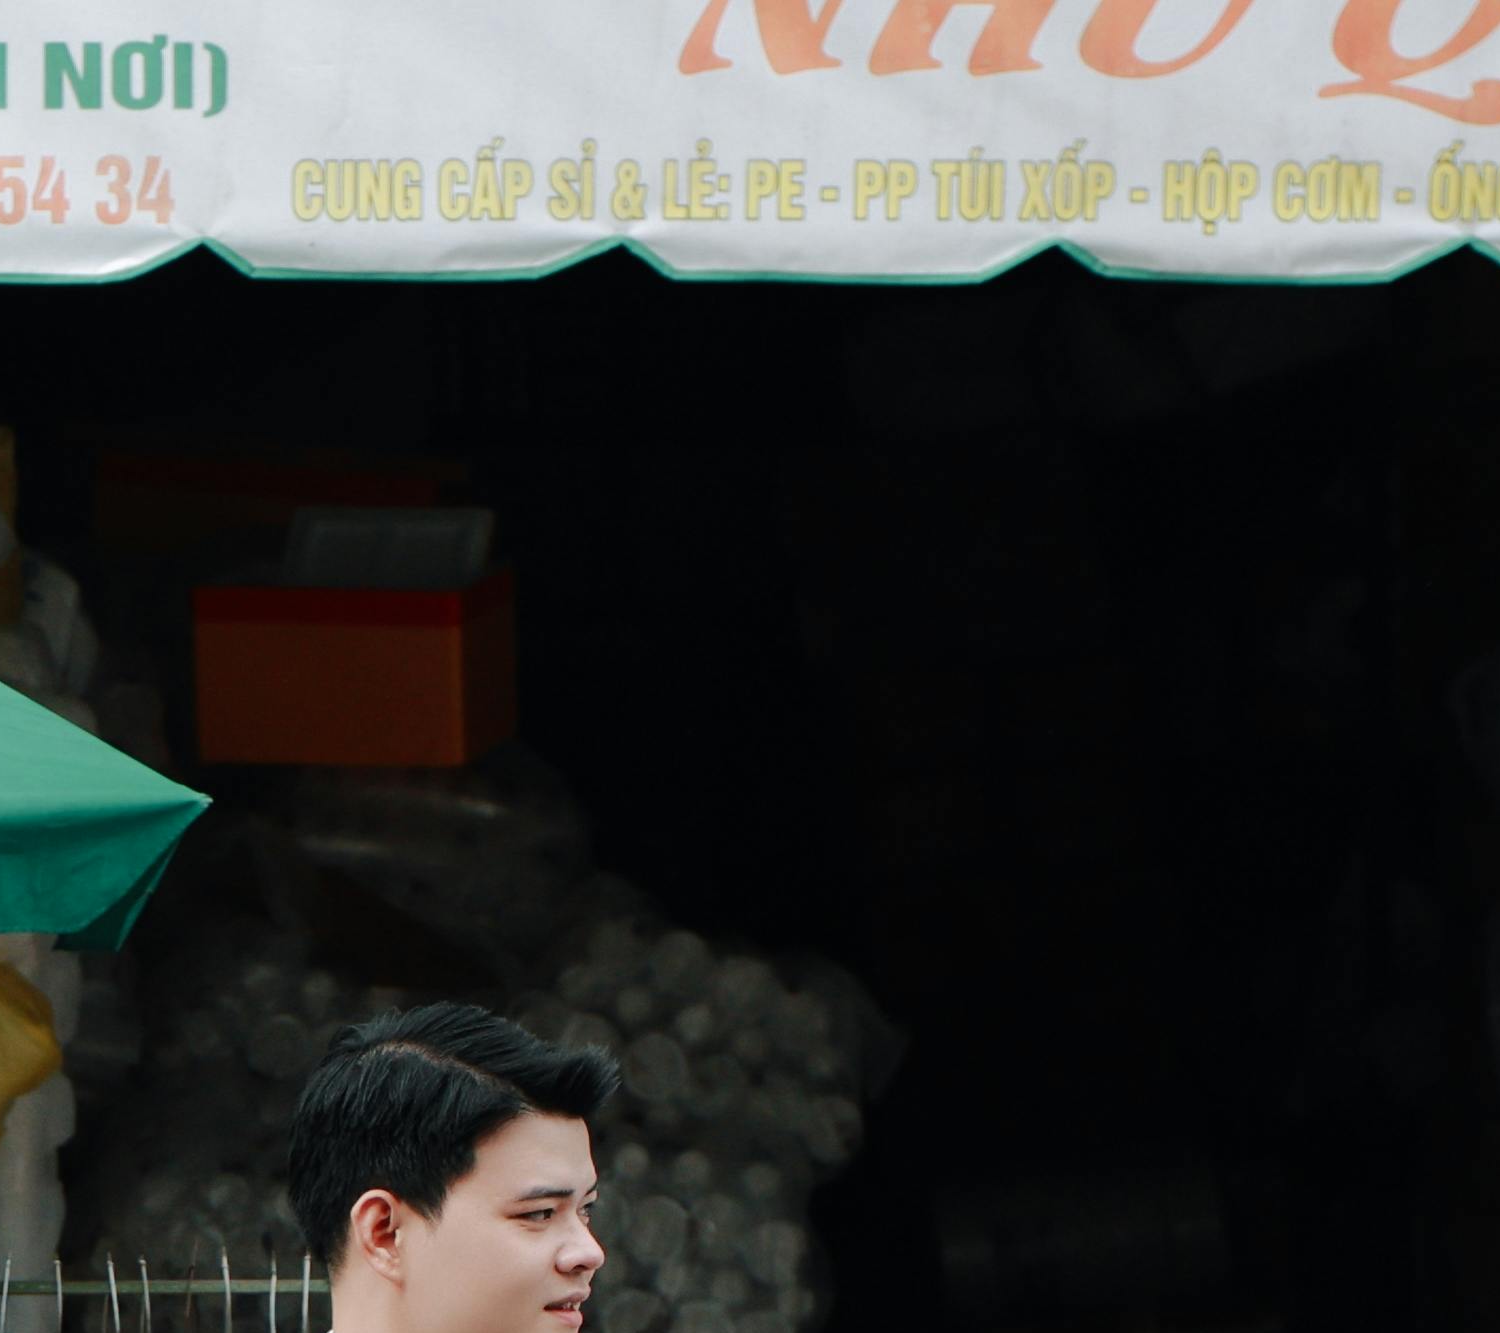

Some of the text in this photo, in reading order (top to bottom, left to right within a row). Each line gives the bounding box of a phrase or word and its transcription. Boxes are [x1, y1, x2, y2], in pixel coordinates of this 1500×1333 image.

[43, 34, 229, 118] NƠI)
[94, 154, 175, 226] 34
[291, 158, 424, 222] CUNG
[438, 136, 534, 222] CẤP
[547, 139, 598, 222] SỈ
[611, 158, 647, 222] &
[660, 139, 732, 222] LẺ:
[745, 159, 806, 222] PE
[818, 184, 840, 203] -
[852, 158, 918, 222] PP
[932, 146, 1006, 222] TÚI
[1017, 139, 1115, 222] XỐP
[1128, 186, 1150, 204] -
[1162, 148, 1259, 236] HỘP
[1273, 156, 1382, 222] CƠM
[1394, 187, 1416, 204] -
